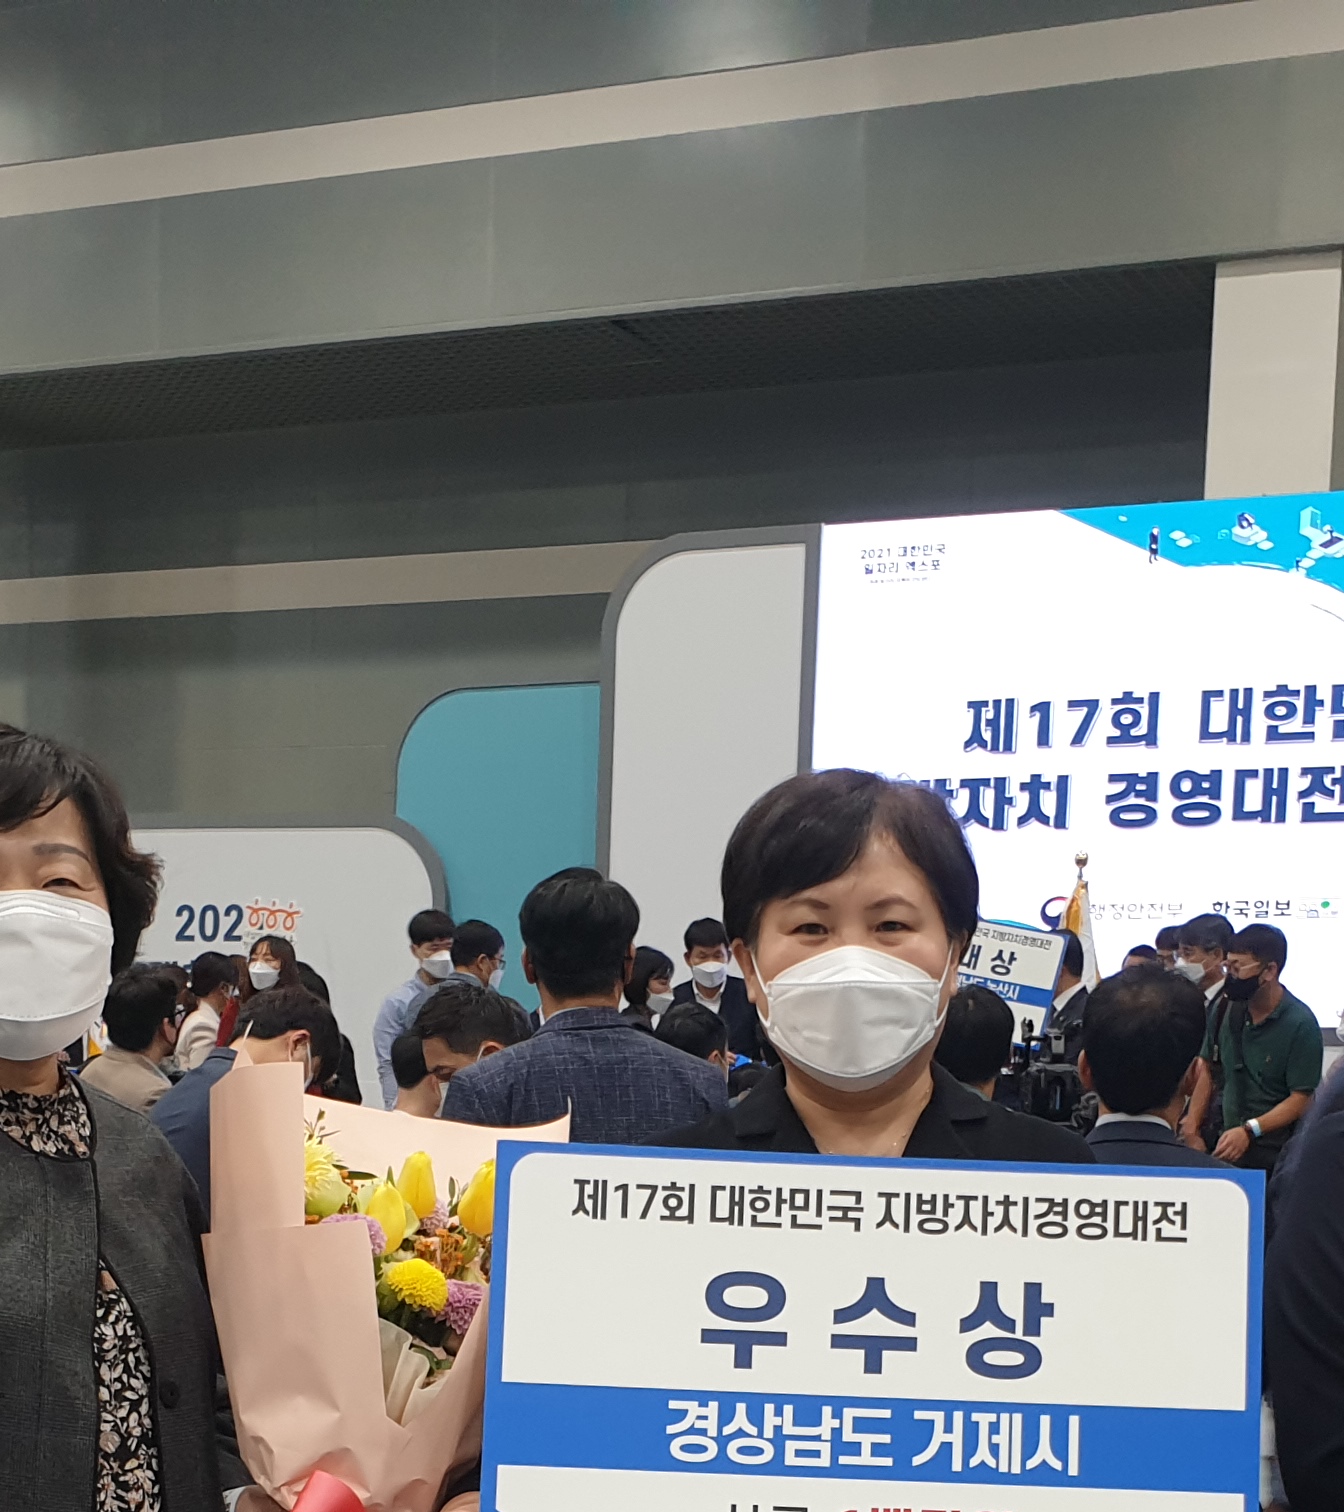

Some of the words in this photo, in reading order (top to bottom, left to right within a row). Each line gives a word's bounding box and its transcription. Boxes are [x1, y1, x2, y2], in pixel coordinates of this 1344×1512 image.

[860, 548, 891, 559] 2021
[897, 543, 946, 557] 대한민국
[963, 691, 1161, 754] 제17회
[175, 904, 264, 942] 202
[1089, 902, 1184, 920] 행정안전부
[1212, 900, 1292, 918] 한국일보
[571, 1177, 694, 1226] 제17회
[708, 1183, 864, 1231] 대한민국
[874, 1189, 1189, 1244] 지방자치경영대전
[664, 1399, 894, 1468] 경상남도
[910, 1408, 1081, 1478] 거제시
